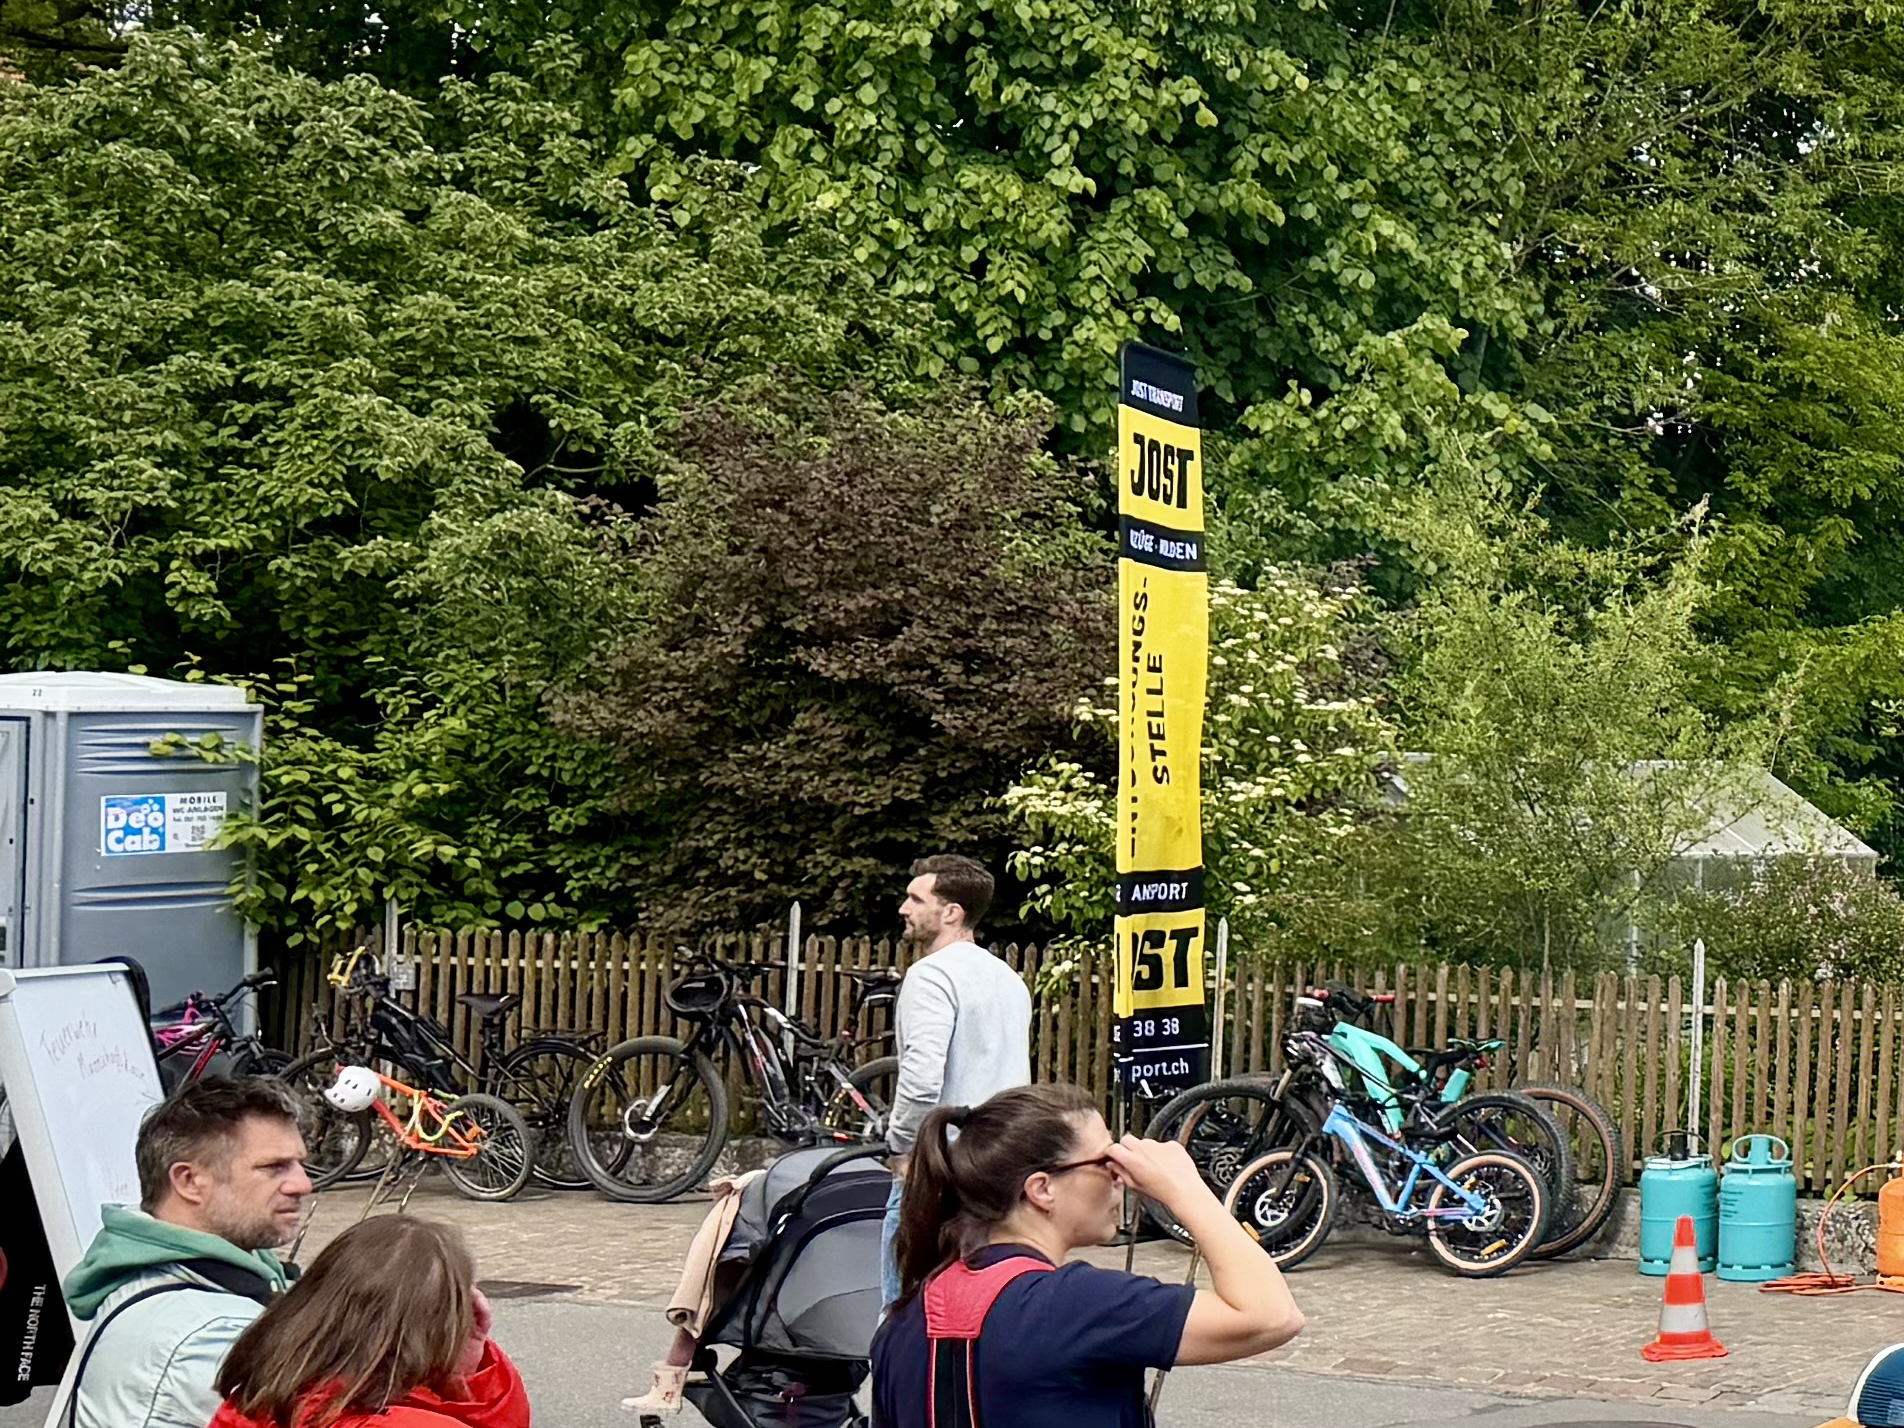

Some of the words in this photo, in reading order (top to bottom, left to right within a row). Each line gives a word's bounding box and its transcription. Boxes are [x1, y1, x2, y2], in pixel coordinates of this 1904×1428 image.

[1130, 432, 1194, 510] JOST
[1146, 652, 1170, 785] STELLE
[107, 827, 161, 852] Cab
[1133, 1020, 1155, 1037] 38
[1162, 1017, 1180, 1035] 38
[30, 1283, 47, 1307] THE
[22, 1308, 41, 1350] NORTH
[17, 1351, 33, 1381] FACE
